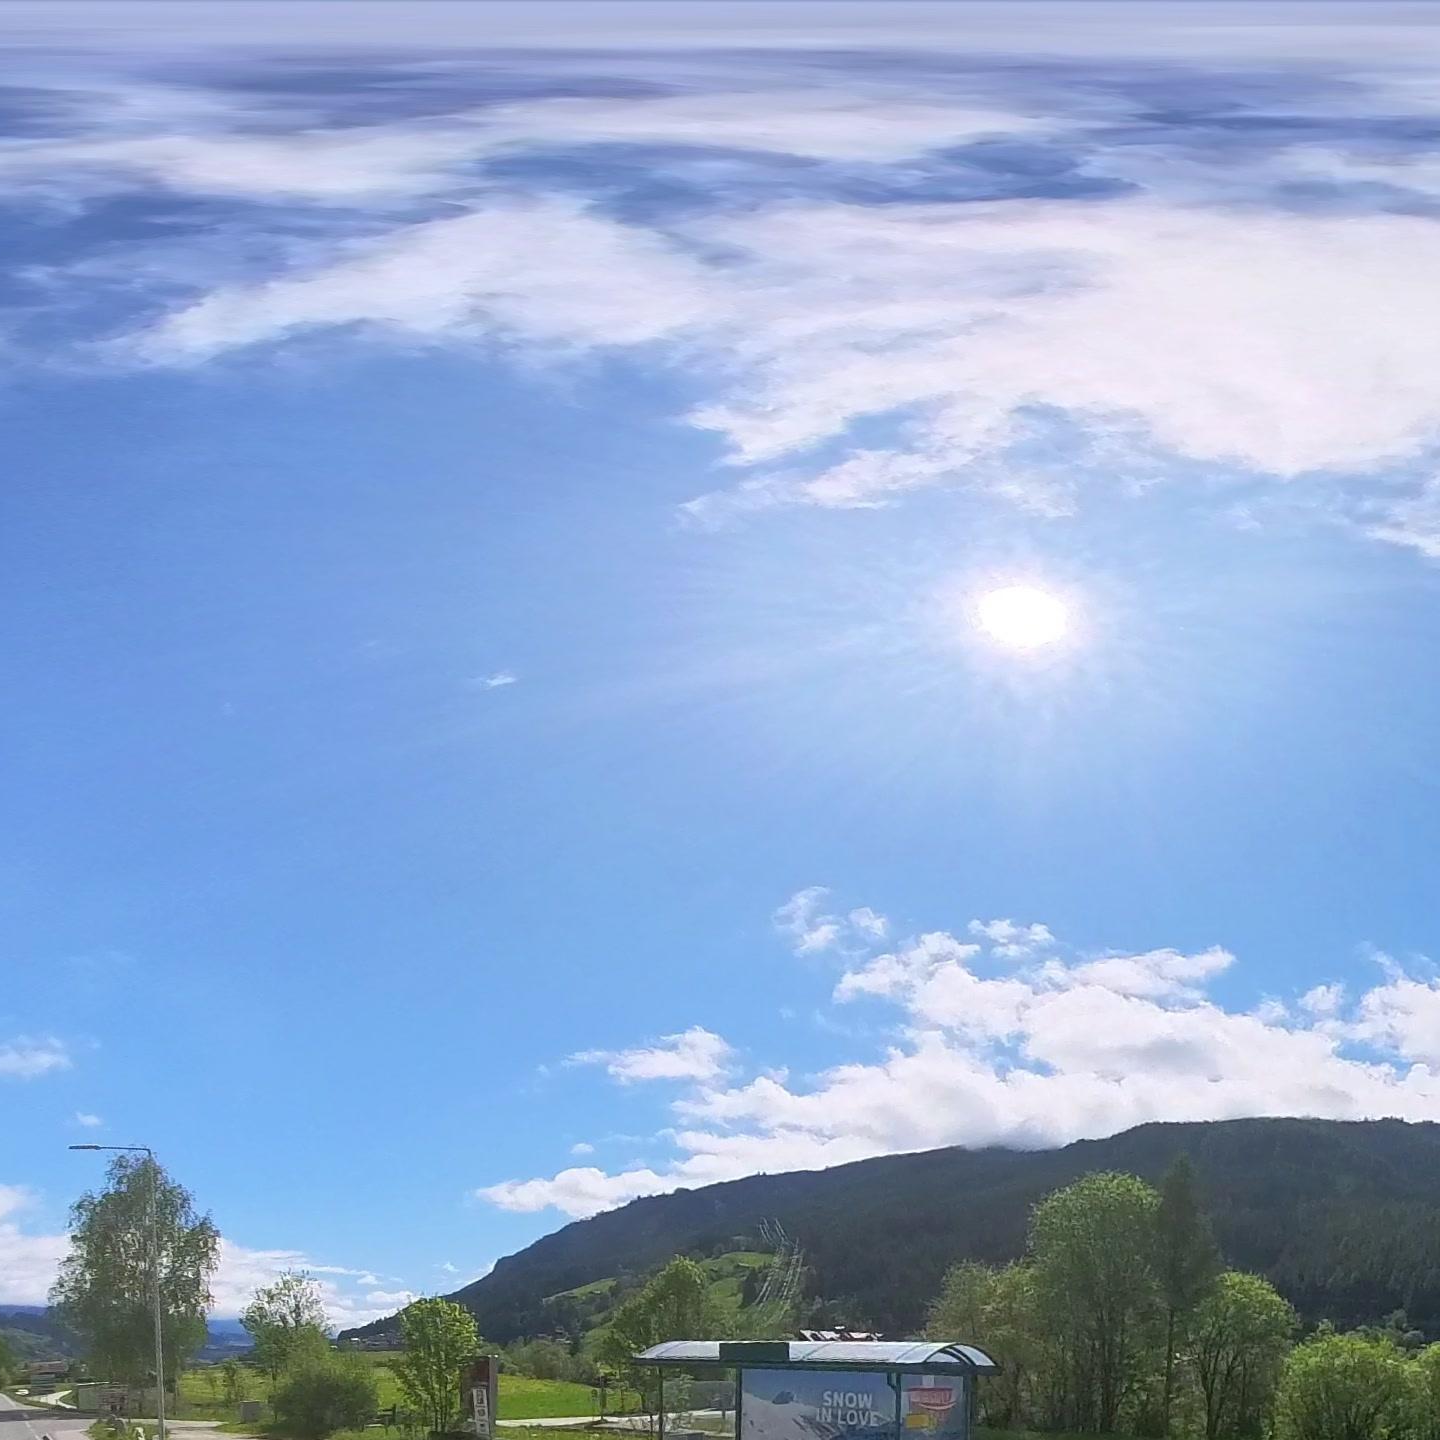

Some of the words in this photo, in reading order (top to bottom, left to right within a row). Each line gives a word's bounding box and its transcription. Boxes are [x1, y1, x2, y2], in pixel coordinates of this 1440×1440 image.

[822, 1391, 873, 1409] SNOW
[816, 1408, 831, 1422] IN
[838, 1409, 880, 1427] LOVE
